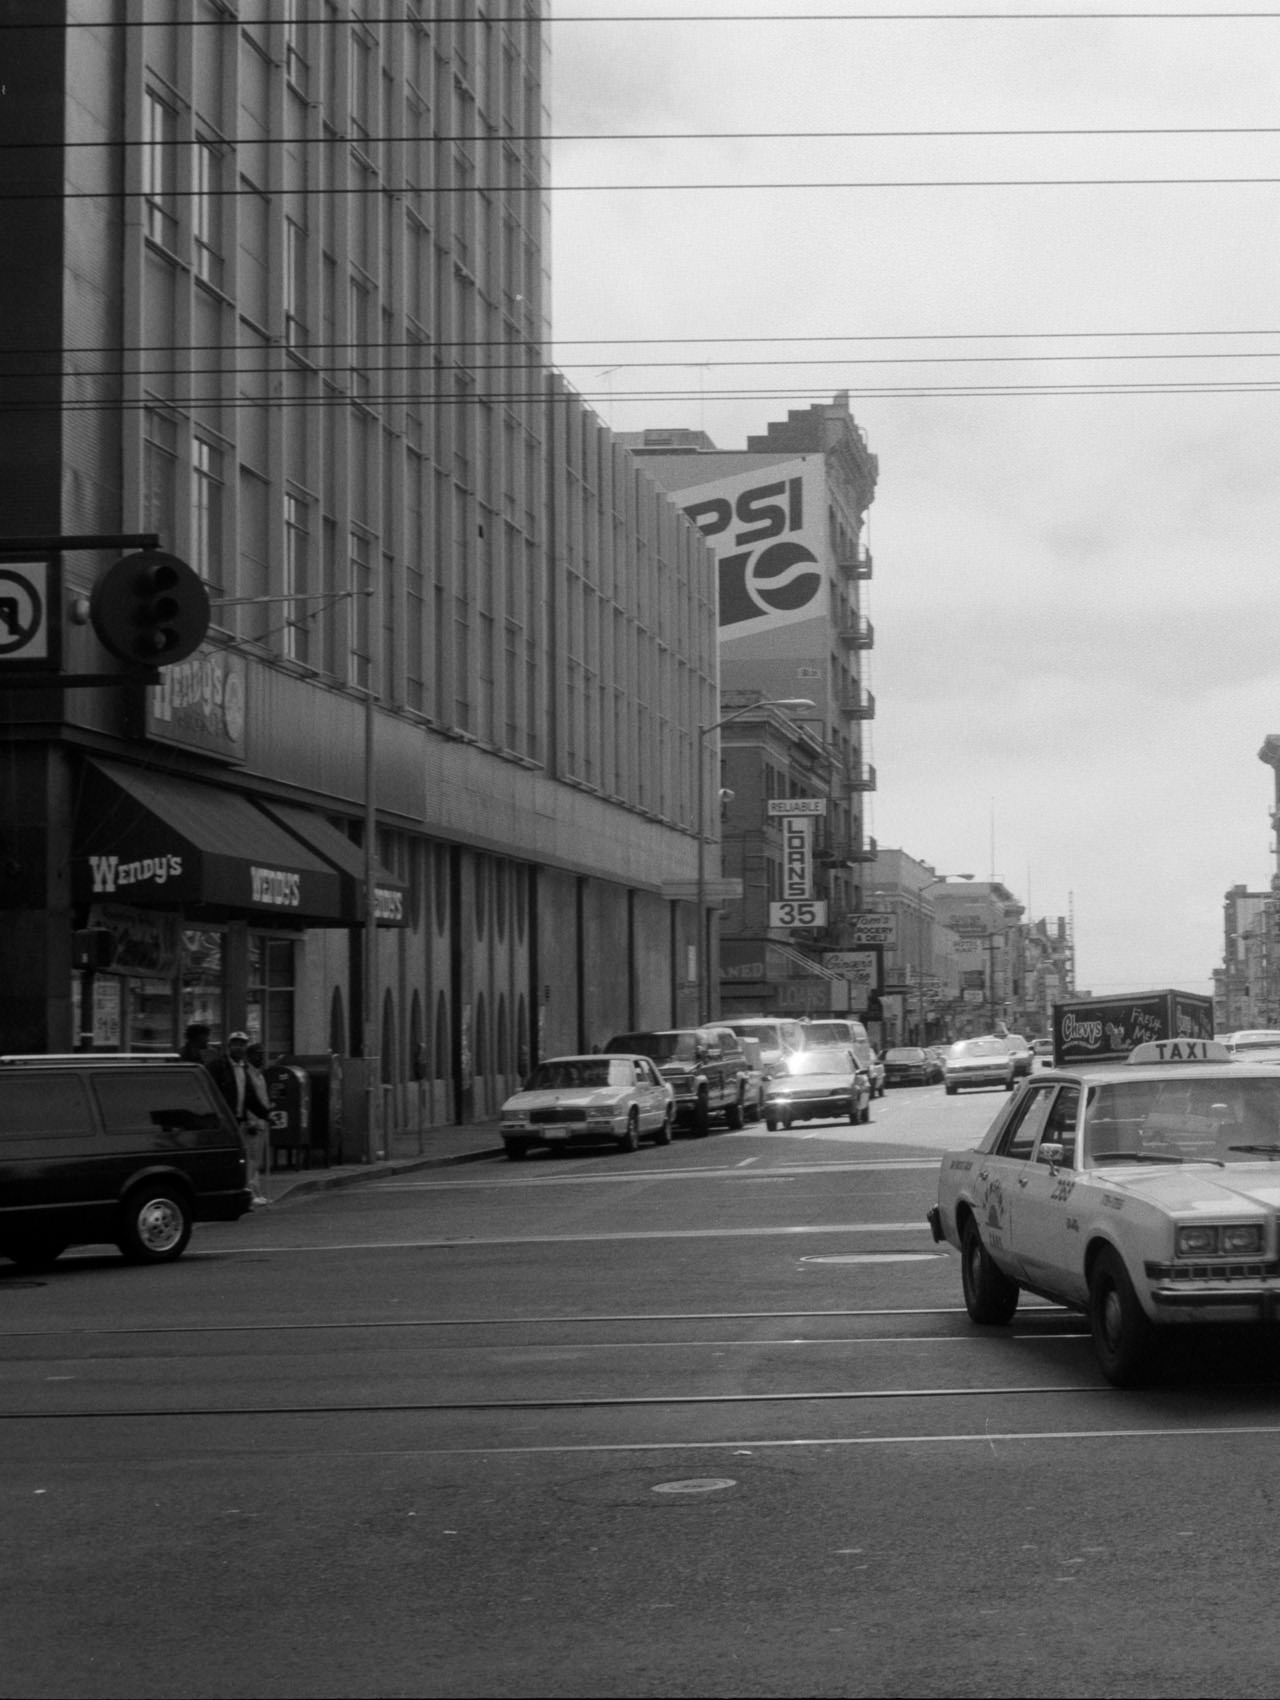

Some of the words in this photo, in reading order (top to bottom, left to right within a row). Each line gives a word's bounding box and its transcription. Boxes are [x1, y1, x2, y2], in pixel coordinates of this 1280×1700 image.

[682, 476, 803, 546] PSI
[770, 801, 820, 813] RELIABLE
[786, 819, 806, 898] LOANS
[87, 853, 183, 893] Wendy's
[778, 903, 817, 926] 35
[856, 926, 894, 936] ROCERY
[1155, 1042, 1208, 1060] TAXI
